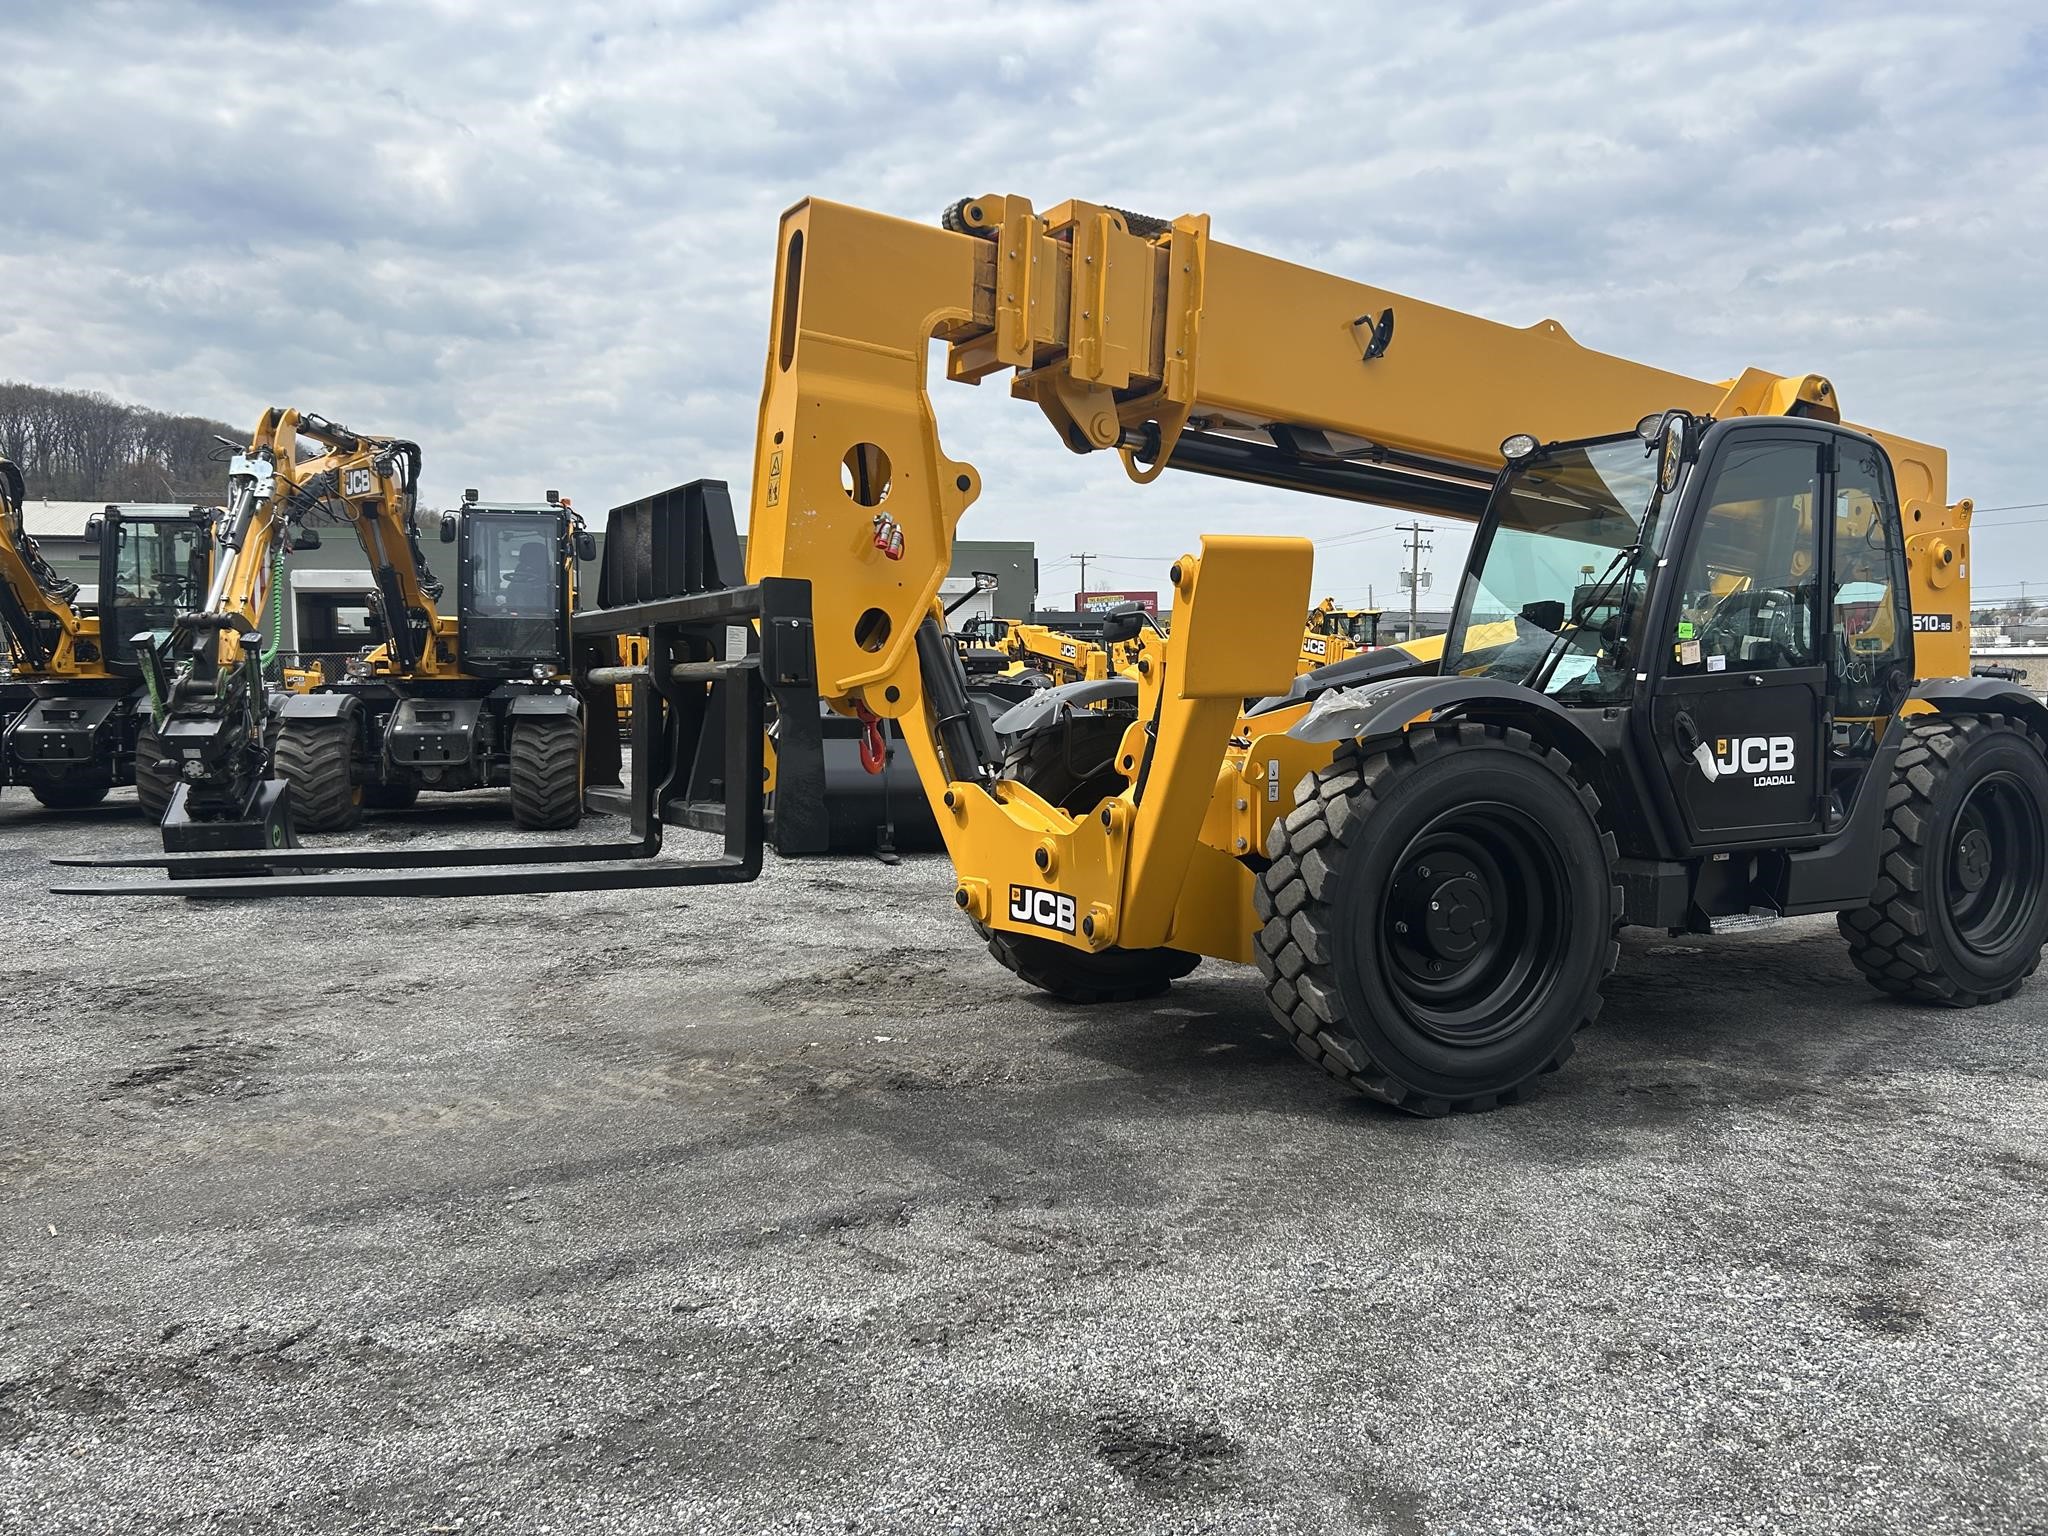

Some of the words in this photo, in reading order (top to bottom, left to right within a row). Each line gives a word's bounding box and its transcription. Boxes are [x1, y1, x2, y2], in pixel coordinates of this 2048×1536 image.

[345, 469, 370, 495] JCB
[1061, 643, 1076, 658] JCB
[1303, 638, 1326, 655] JCB
[1717, 736, 1795, 775] JCB
[1753, 774, 1796, 787] LOADALL
[1011, 888, 1075, 932] JCB
